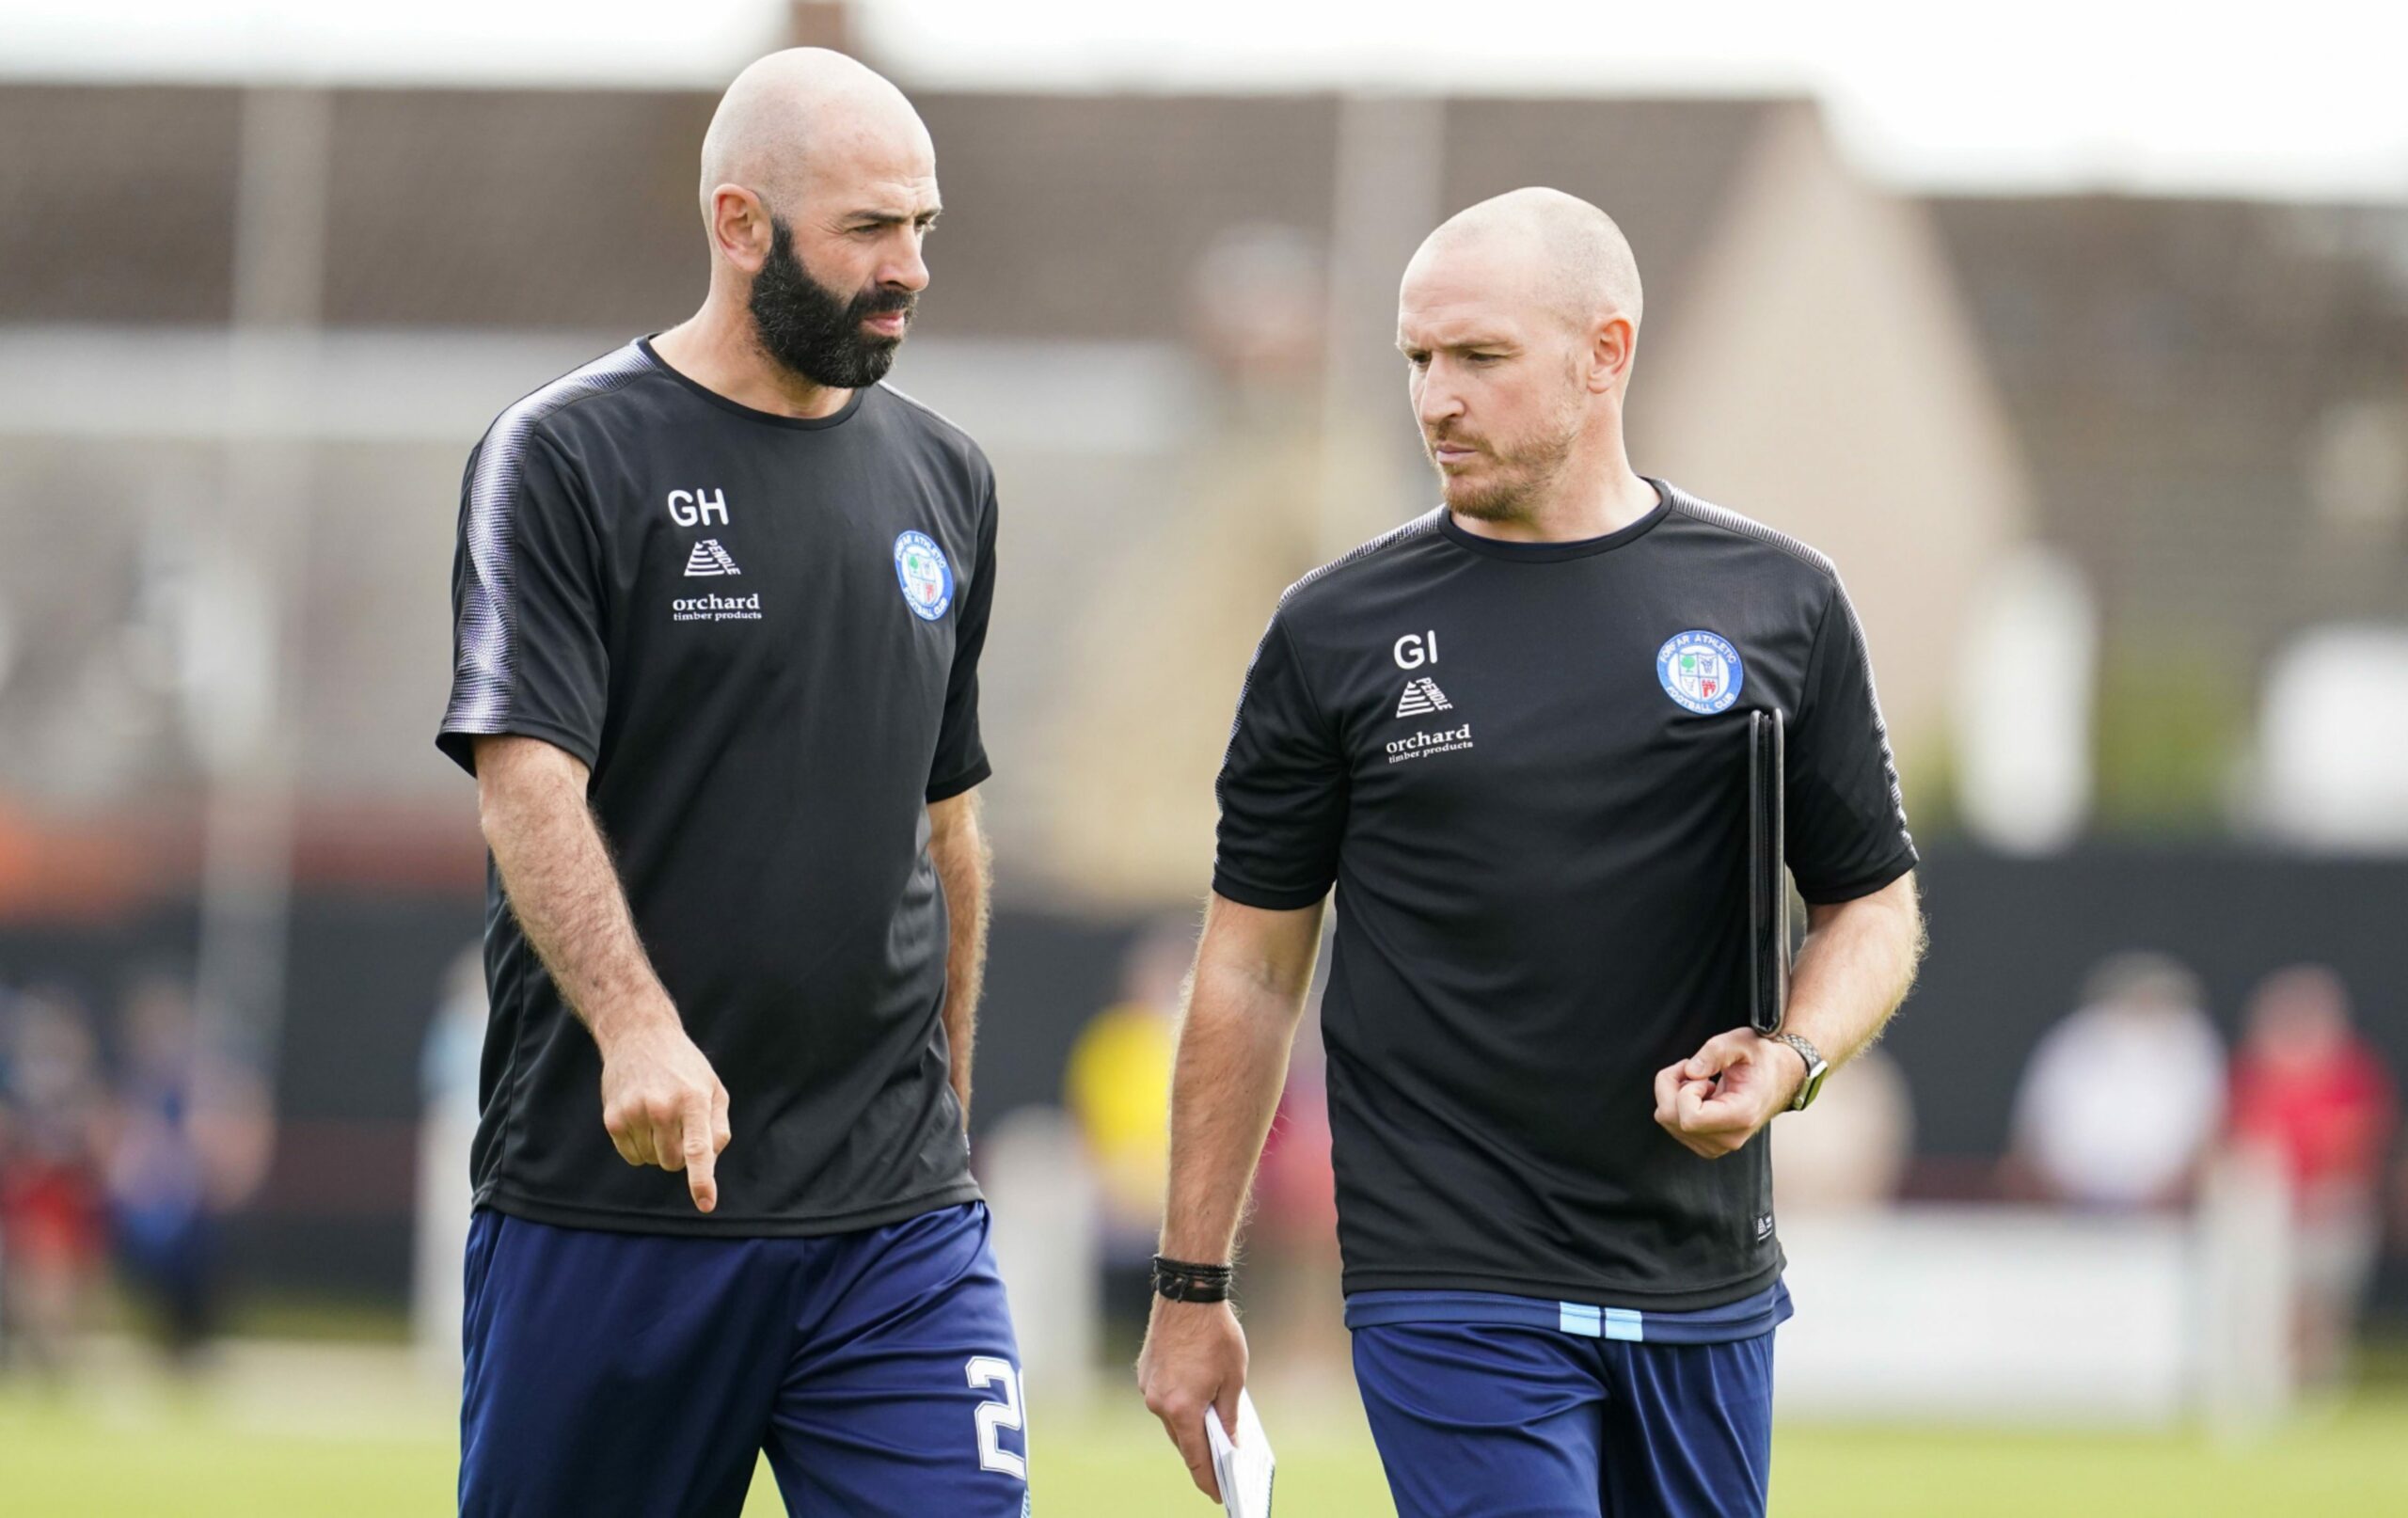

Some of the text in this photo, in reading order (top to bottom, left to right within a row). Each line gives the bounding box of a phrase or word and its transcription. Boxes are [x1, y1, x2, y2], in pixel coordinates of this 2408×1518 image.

[668, 488, 729, 527] GH
[702, 539, 741, 576] PENDLE
[673, 593, 760, 611] orchard
[673, 611, 763, 622] timber products
[1393, 629, 1438, 670] GI
[1416, 676, 1453, 711] PENDLE
[1386, 723, 1471, 754] orchard
[1388, 741, 1474, 764] timber products
[965, 1355, 1029, 1480] 2
